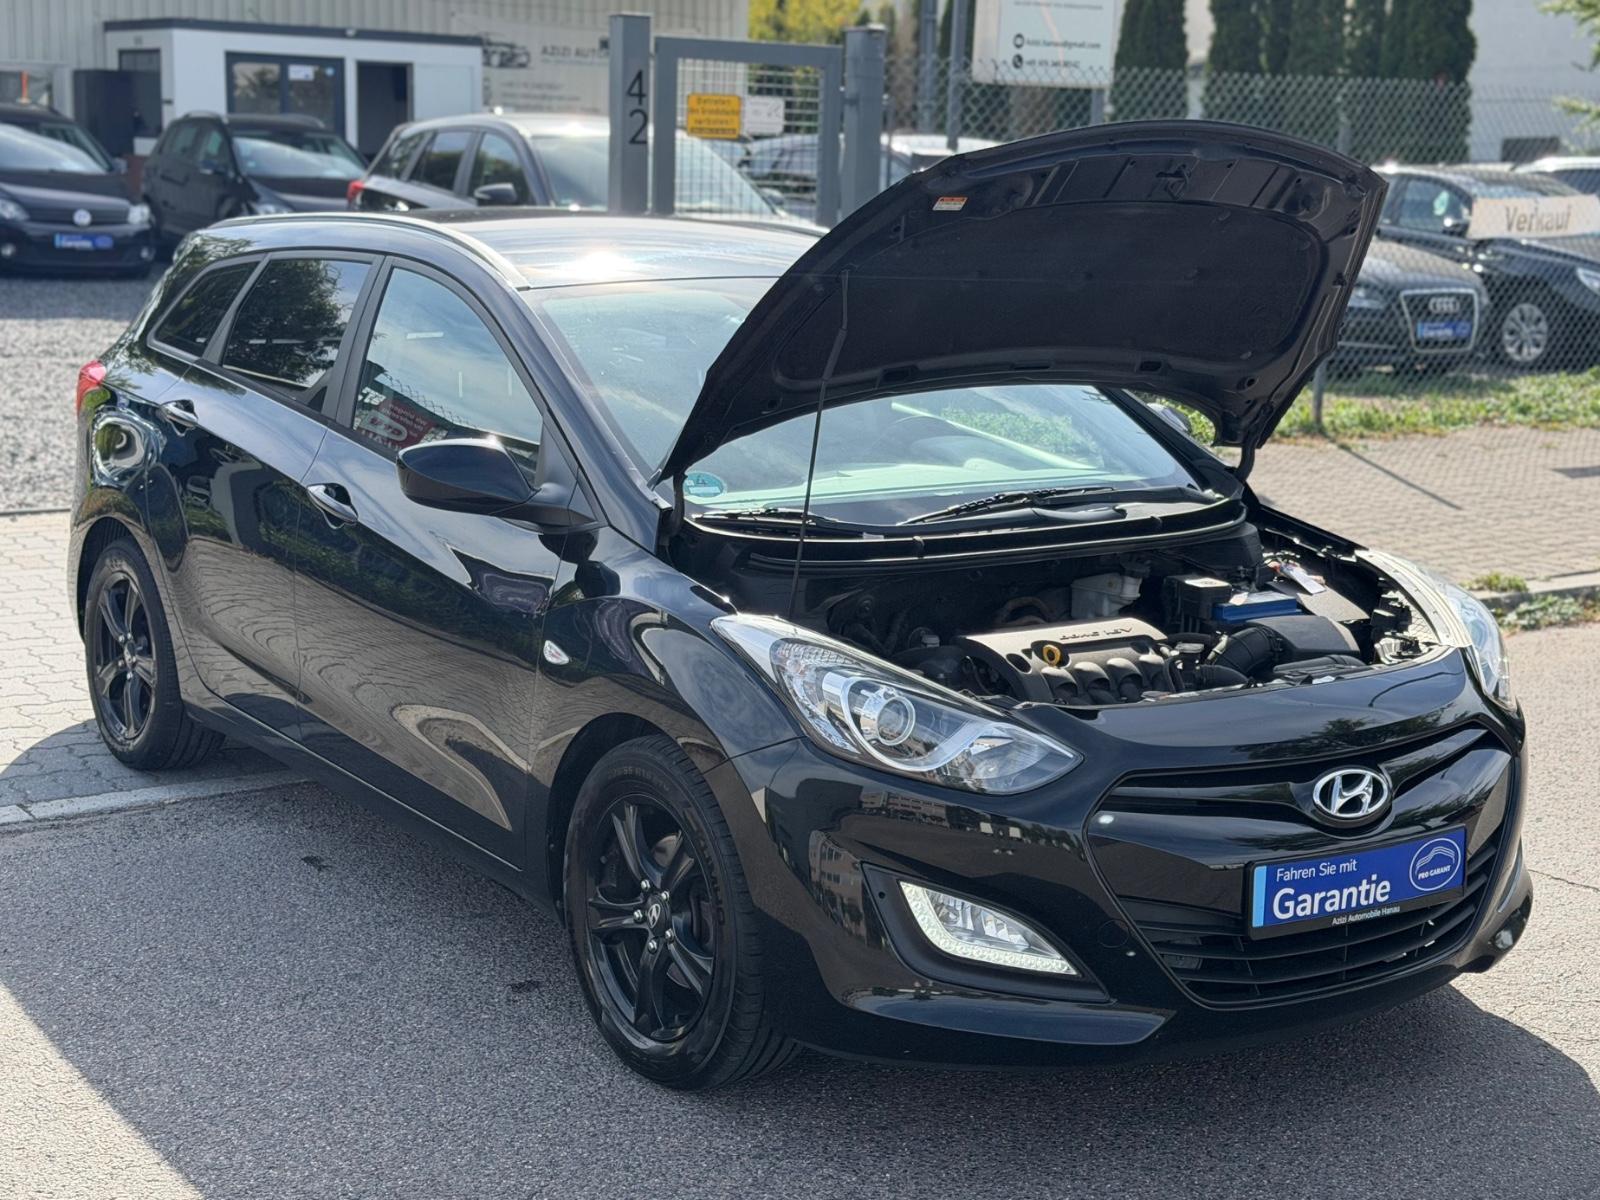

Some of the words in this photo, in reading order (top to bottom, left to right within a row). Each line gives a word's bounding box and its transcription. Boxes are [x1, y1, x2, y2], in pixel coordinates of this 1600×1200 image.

[1276, 866, 1316, 882] Fahren
[1319, 862, 1336, 877] Sie
[1339, 859, 1357, 873] mit
[1417, 871, 1429, 880] PRO
[1429, 865, 1452, 878] GARANT
[1273, 874, 1391, 919] Garantie
[1332, 916, 1348, 926] Azizi
[1348, 909, 1381, 923] Automobile
[1381, 905, 1400, 916] Hanau
